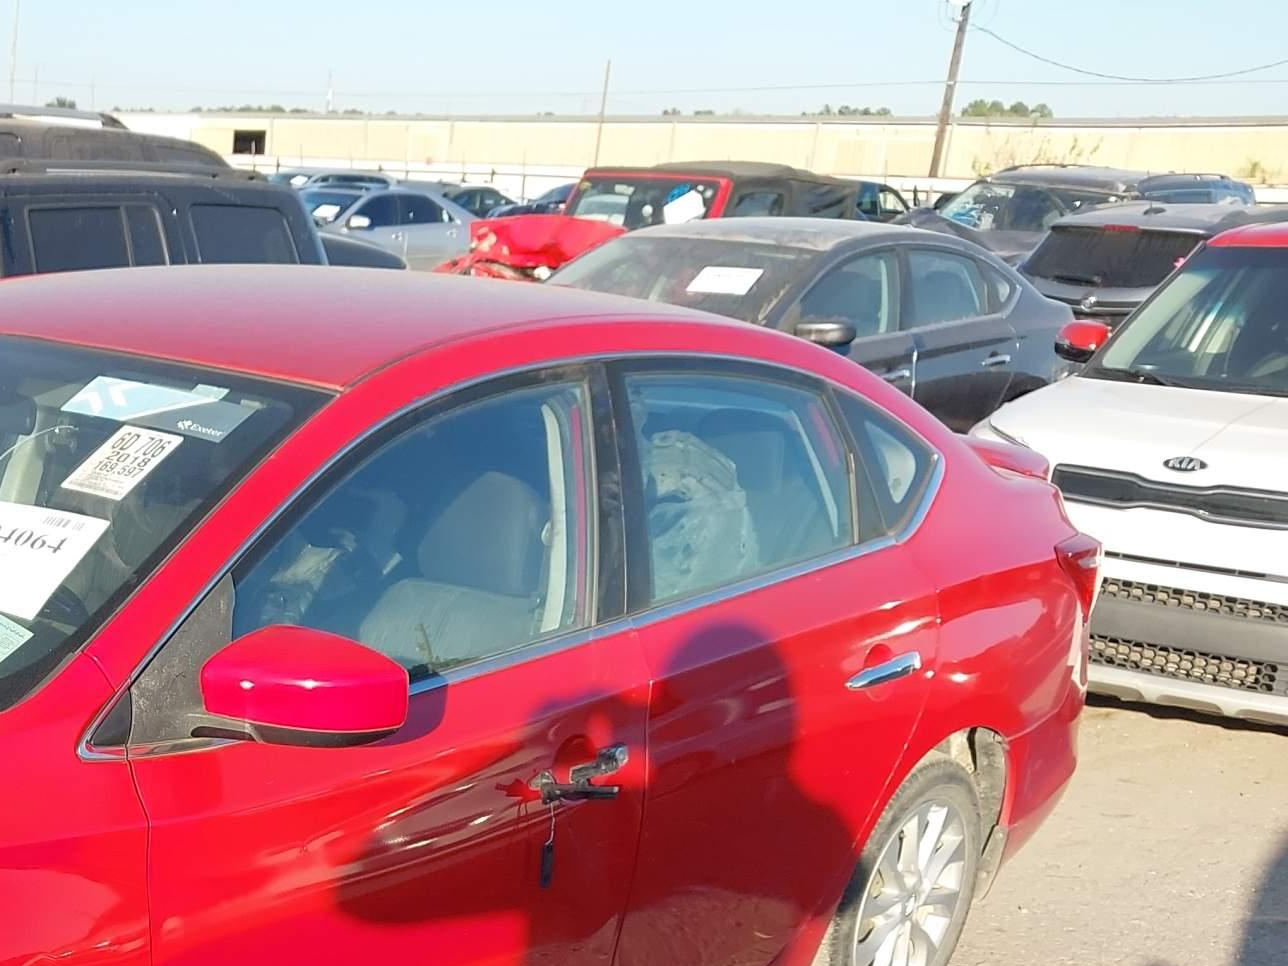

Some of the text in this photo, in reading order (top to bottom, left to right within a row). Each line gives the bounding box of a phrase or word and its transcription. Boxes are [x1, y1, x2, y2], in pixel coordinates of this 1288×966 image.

[111, 431, 172, 458] 6D 706
[104, 450, 152, 469] 2018
